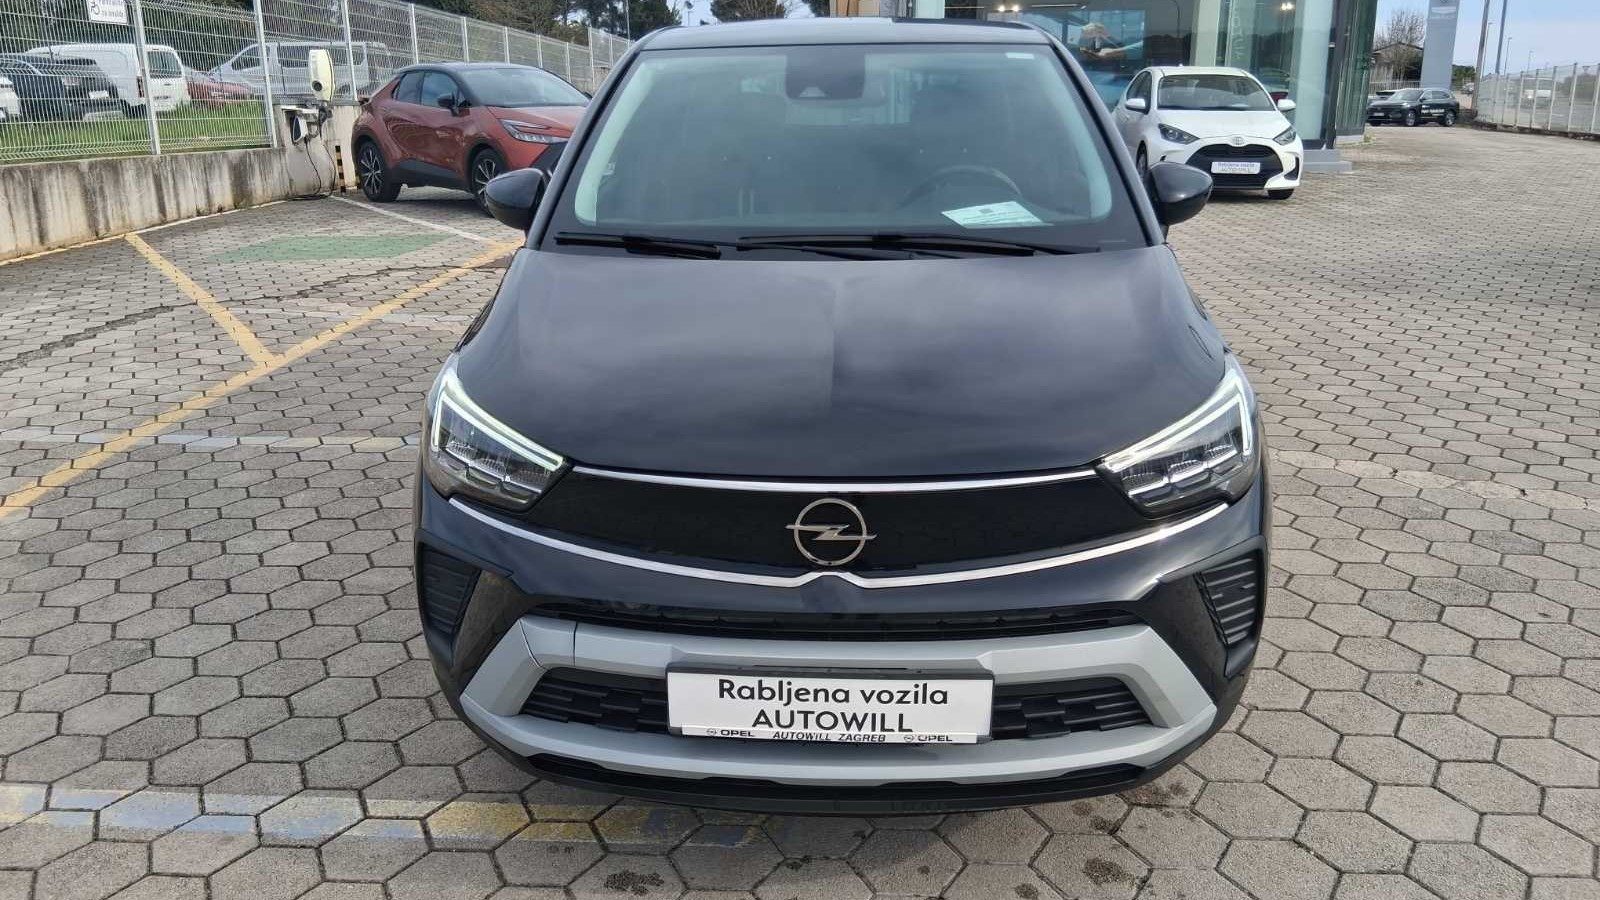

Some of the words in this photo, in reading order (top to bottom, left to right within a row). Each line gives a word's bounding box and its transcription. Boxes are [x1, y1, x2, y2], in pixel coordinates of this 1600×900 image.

[718, 679, 850, 706] Rabljena
[860, 683, 949, 705] vozila
[752, 709, 913, 732] AUTOWILL
[720, 729, 756, 737] OPEL
[773, 731, 831, 741] AUTOWILL
[838, 733, 886, 742] ZAGREB
